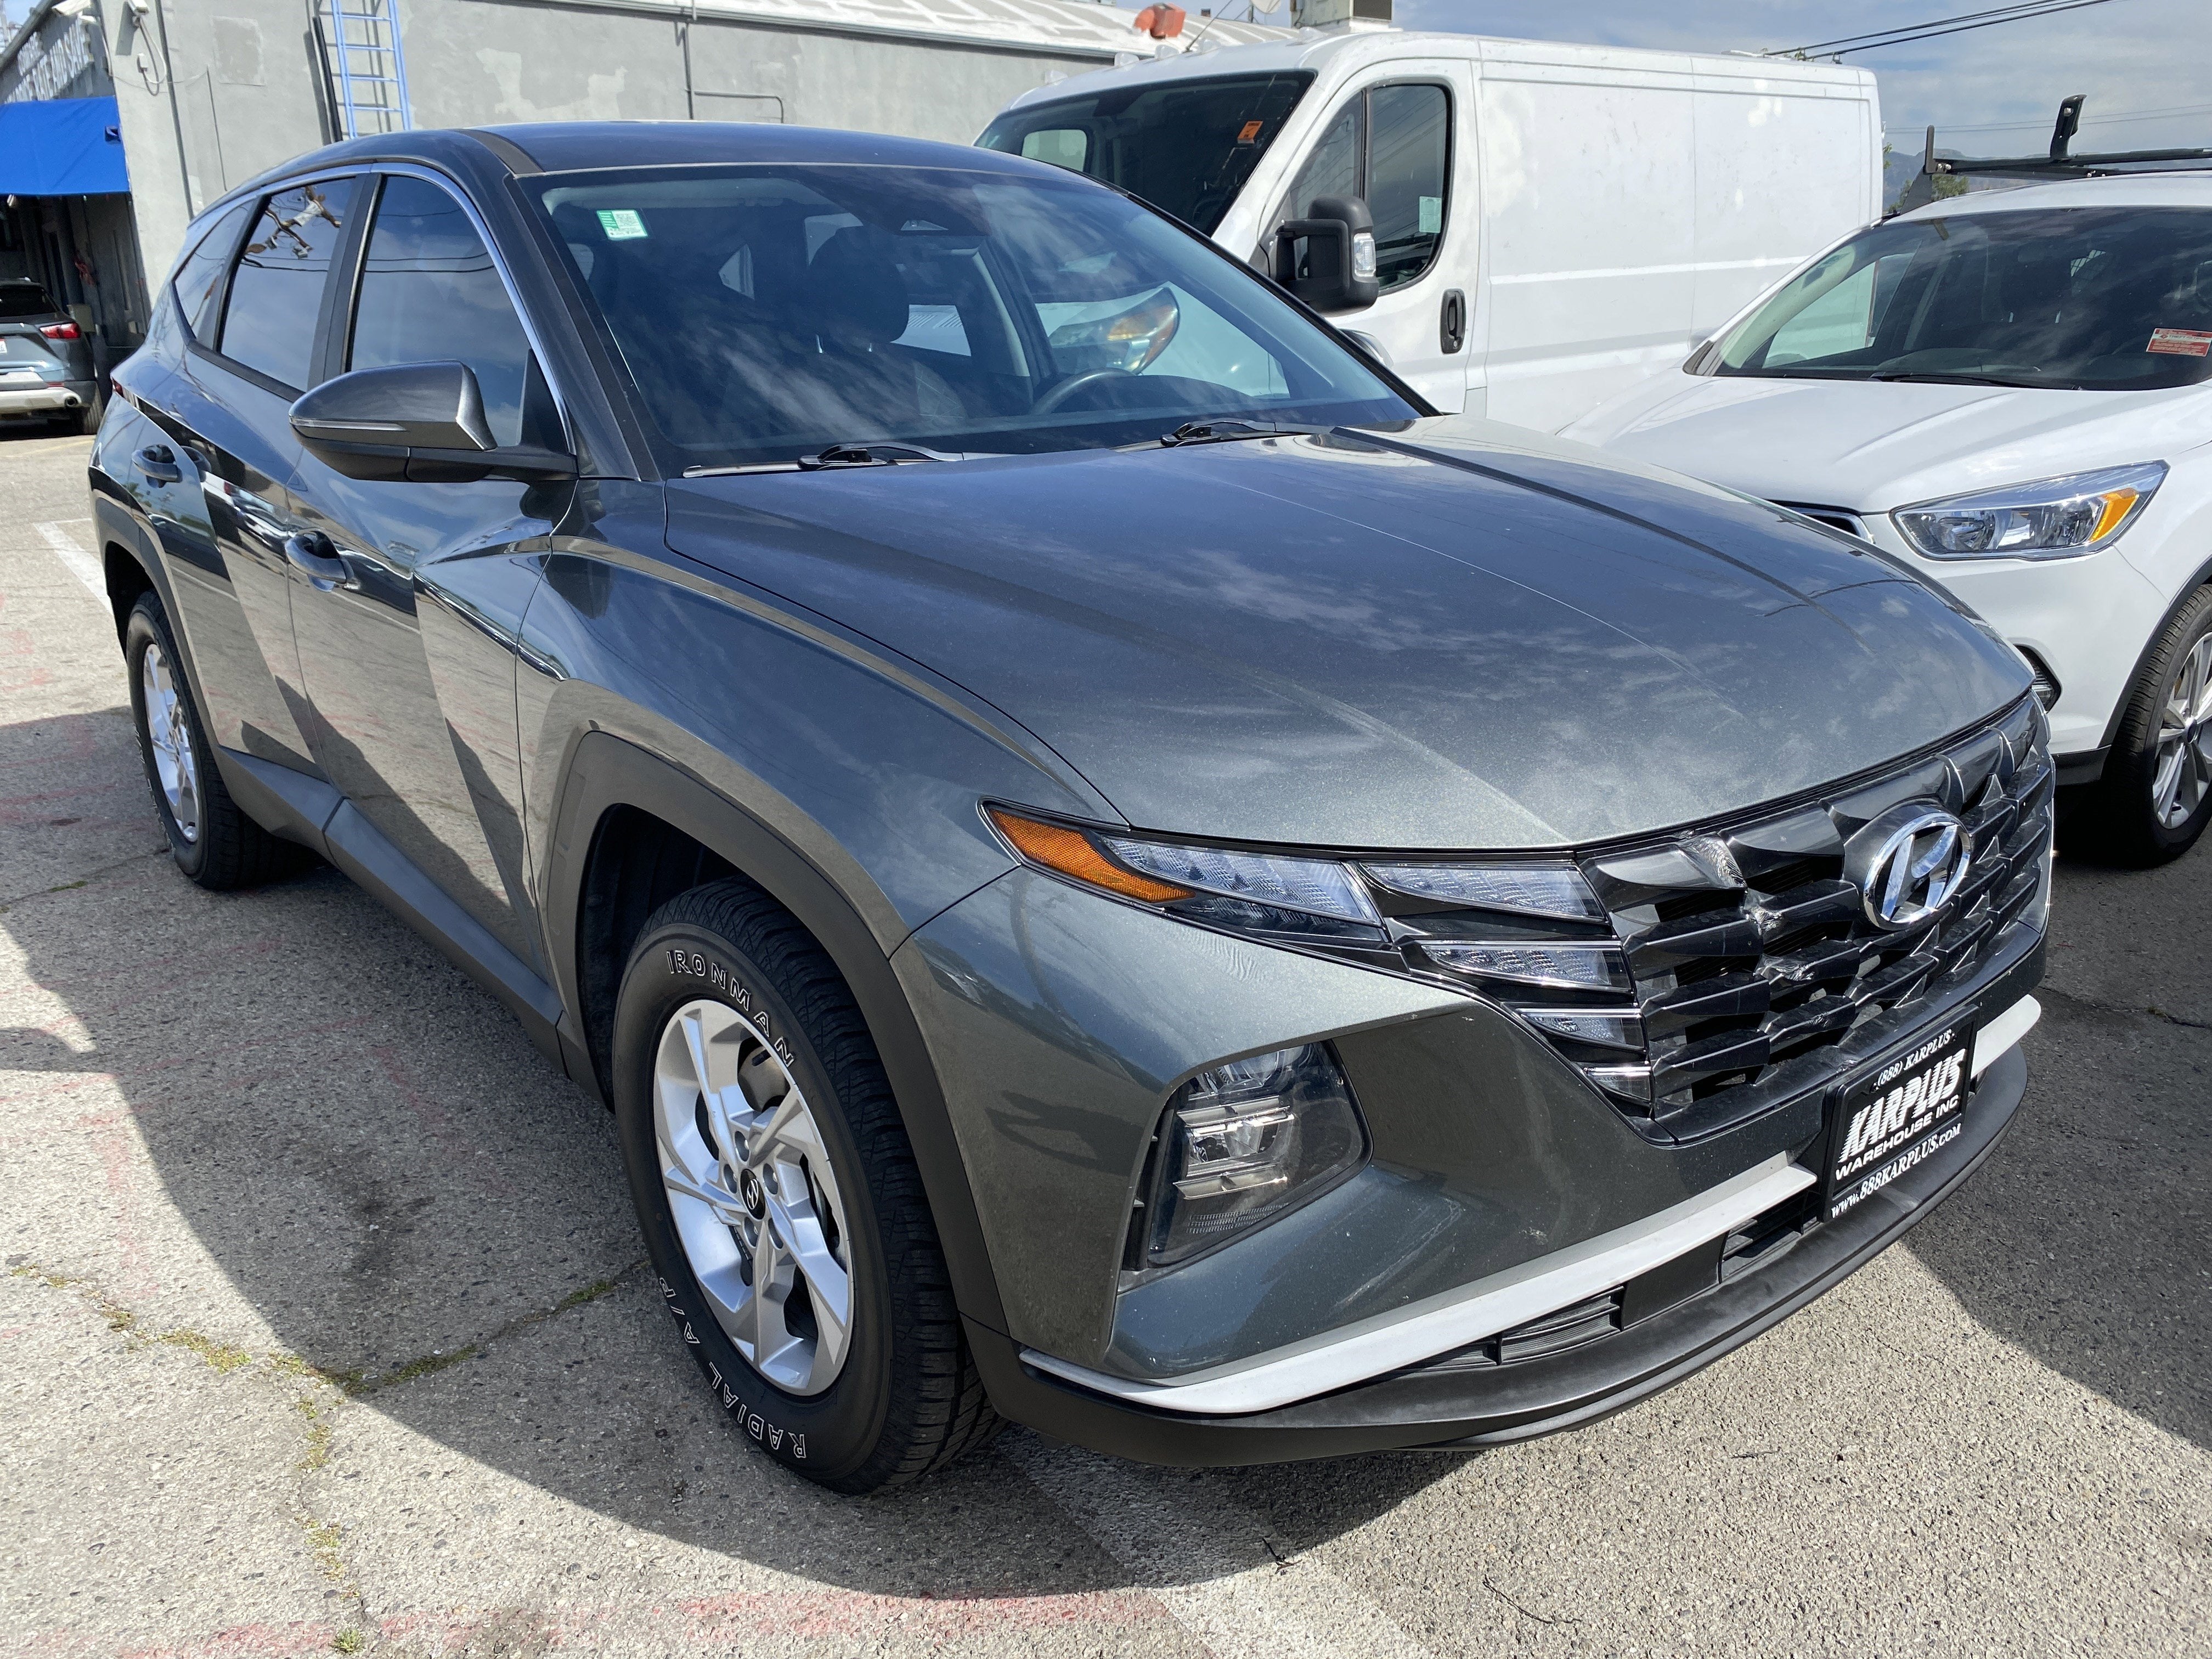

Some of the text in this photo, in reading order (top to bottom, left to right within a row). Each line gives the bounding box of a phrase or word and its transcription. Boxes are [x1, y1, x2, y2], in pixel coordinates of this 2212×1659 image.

[667, 950, 794, 1067] IRONMAN
[1878, 1029, 1952, 1086] (888) KARPLUS
[1836, 1094, 1959, 1181] WAREHOUSE INC
[1838, 1048, 1966, 1163] KARPLUS
[709, 1361, 806, 1459] RADIAL
